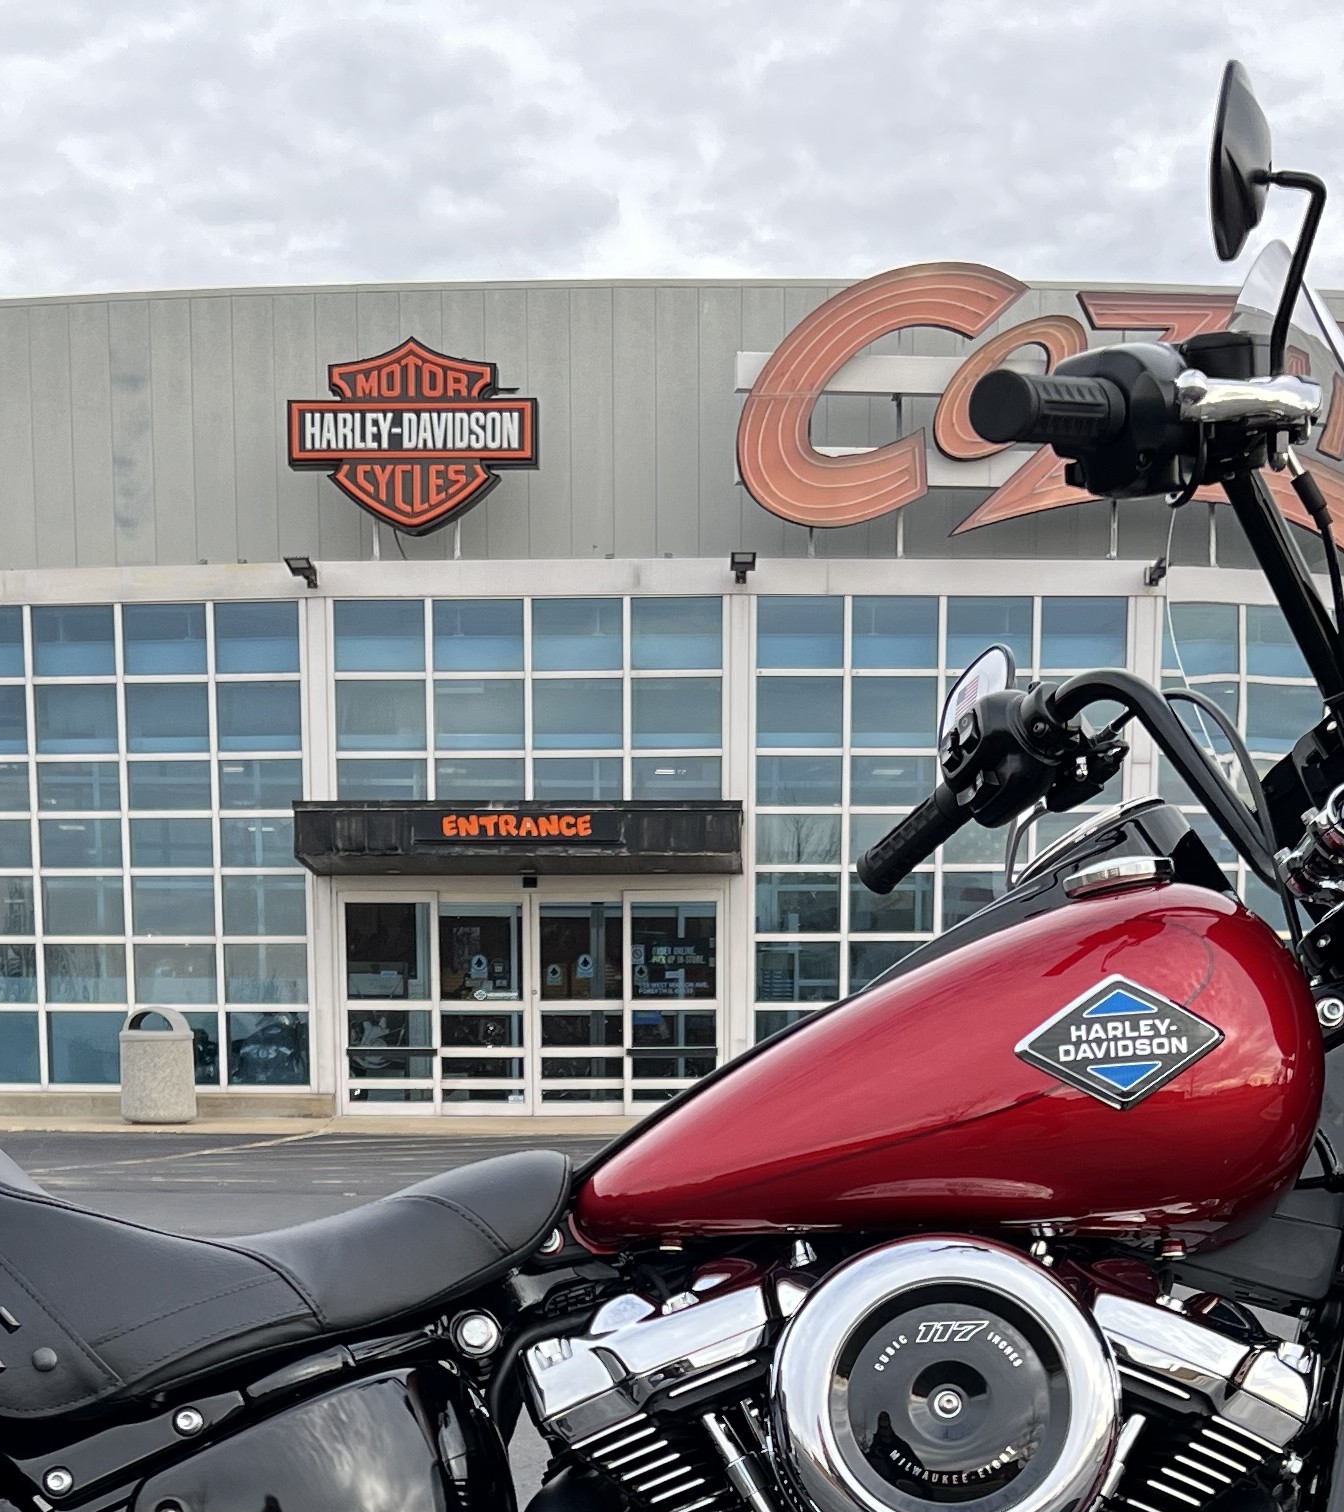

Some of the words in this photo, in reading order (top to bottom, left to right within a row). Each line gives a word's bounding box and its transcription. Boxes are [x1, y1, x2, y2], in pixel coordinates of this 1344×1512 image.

[356, 354, 468, 398] MOTOR
[304, 411, 520, 450] HARLEY-DAVIDSON
[356, 464, 467, 513] CYCLES
[441, 814, 593, 838] ENTRANCE
[1058, 1037, 1188, 1062] DAVIDSON
[1070, 1018, 1178, 1042] HARLEY-
[874, 1334, 908, 1372] CUBIC
[915, 1320, 990, 1344] 117
[986, 1331, 1024, 1368] INCHES
[889, 1444, 1017, 1485] MILWAUKEE-EIGHT
